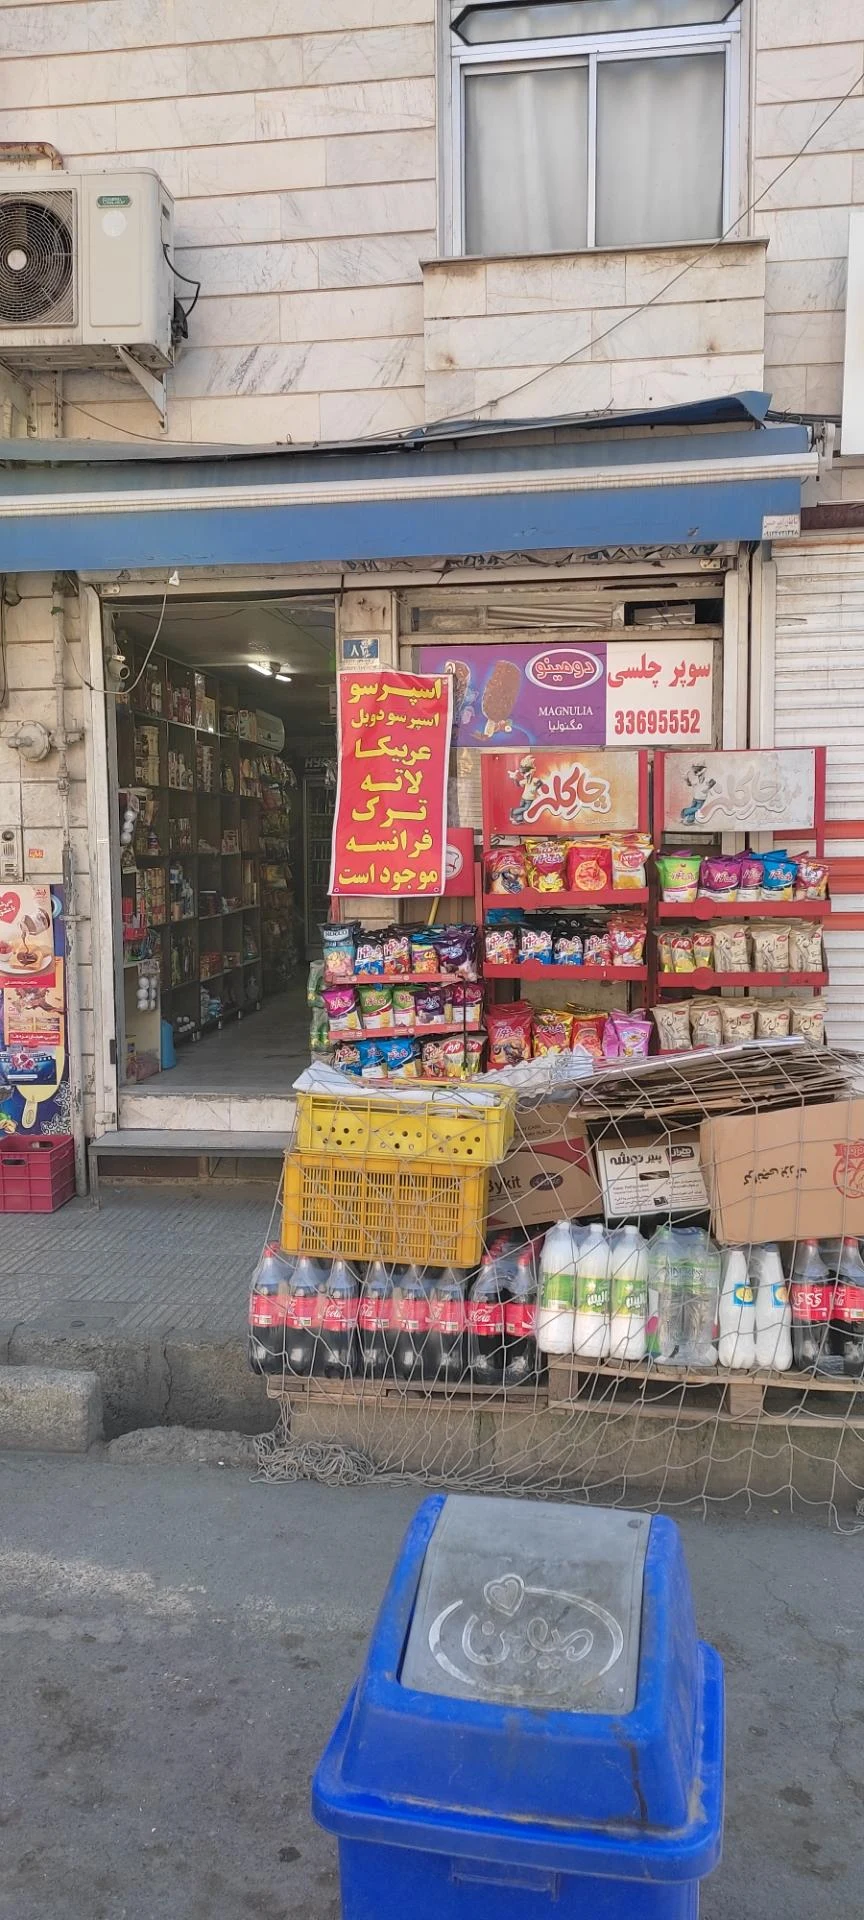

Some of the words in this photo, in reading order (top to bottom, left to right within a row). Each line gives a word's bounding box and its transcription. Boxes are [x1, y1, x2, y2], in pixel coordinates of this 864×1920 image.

[534, 659, 595, 682] دومینو
[607, 653, 662, 688] چلسی
[668, 662, 711, 688] سوپر
[347, 678, 442, 706] اسپرسو
[350, 708, 385, 729] دوبل
[387, 712, 440, 731] اسپرسو
[538, 706, 594, 717] MAGNULIA
[614, 709, 701, 735] 33695552
[547, 719, 583, 732] مگنولیا
[354, 736, 432, 766] عربیکا
[360, 769, 423, 795] لاته
[526, 763, 609, 818] چاکلز
[351, 797, 427, 828] ترک
[345, 829, 433, 858] فرانسه
[338, 863, 375, 885] است
[379, 865, 438, 891] موجود
[461, 1613, 595, 1670] میهن
